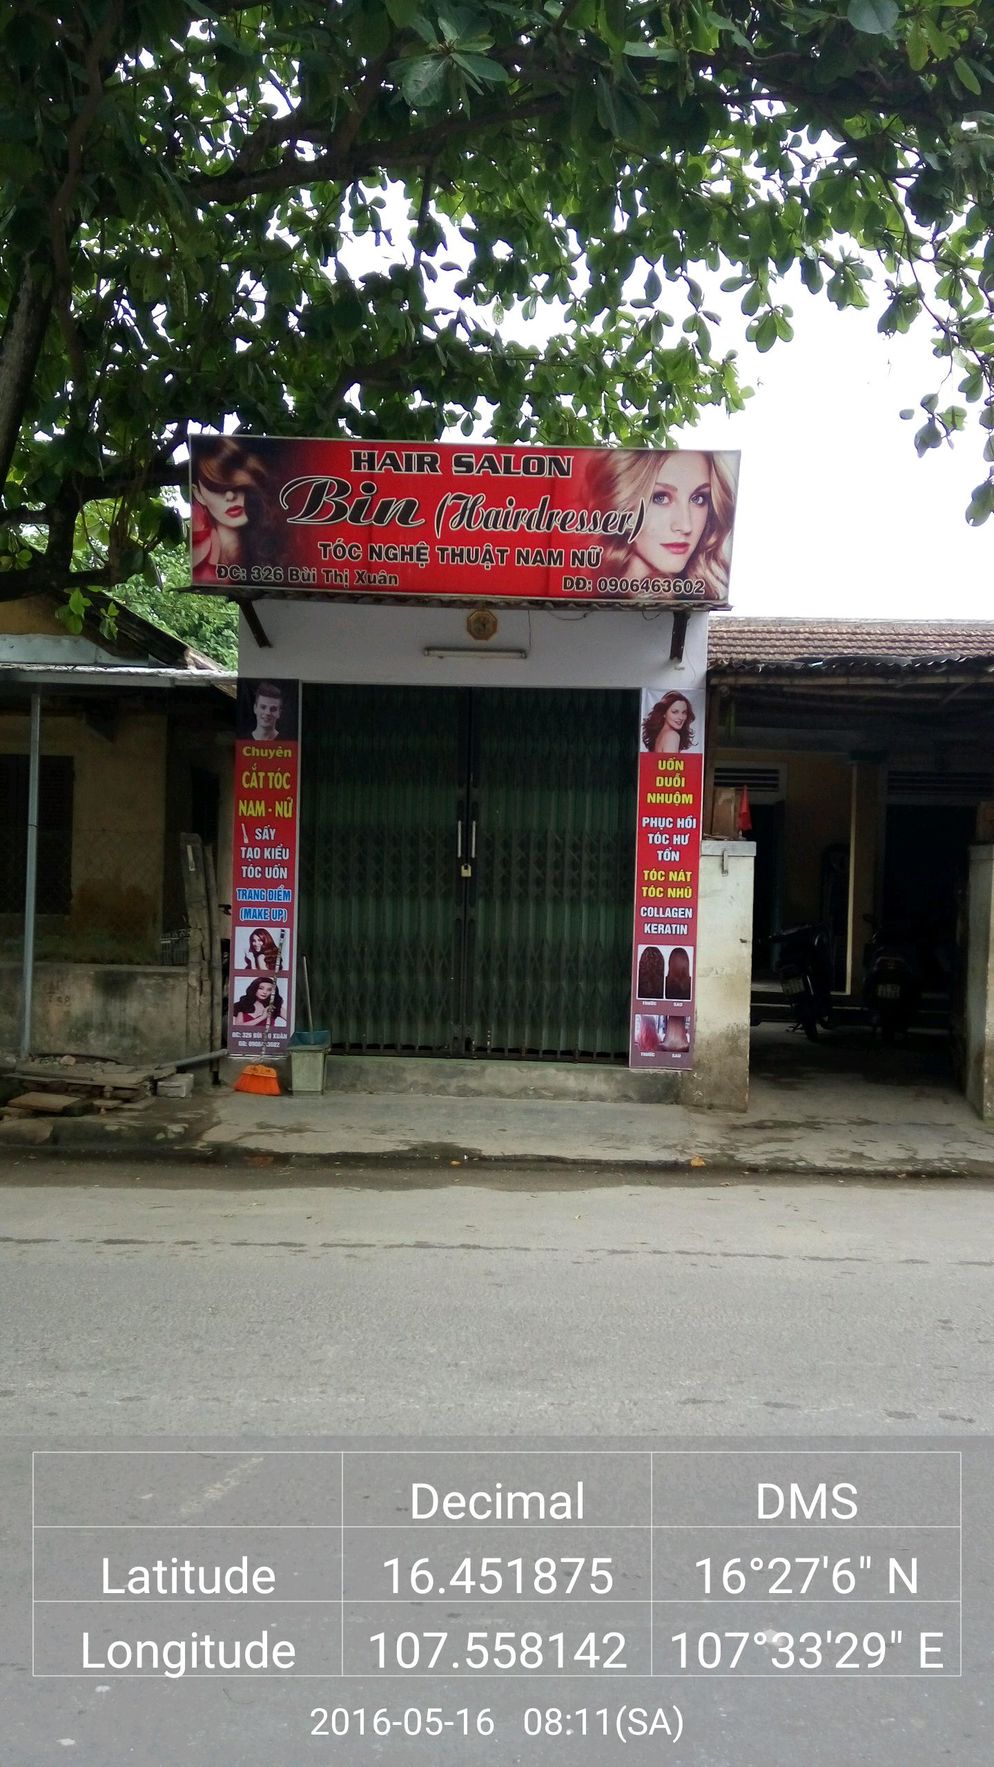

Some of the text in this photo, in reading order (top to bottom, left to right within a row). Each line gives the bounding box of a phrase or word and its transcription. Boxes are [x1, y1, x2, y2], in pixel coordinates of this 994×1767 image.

[351, 450, 574, 478] HAIR SALON
[279, 475, 645, 544] Bin (Hairdresser)
[318, 538, 604, 570] TÓC NGHỆ THUẬT NAM NỮ
[216, 565, 398, 588] ĐC: 326 Bùi Thị Xuân
[562, 576, 705, 594] DĐ: 0906463602
[243, 746, 292, 759] Chuyên
[658, 757, 684, 771] UỐN
[242, 763, 291, 789] CẮT TÓC
[655, 773, 686, 787] DUỖI
[647, 791, 693, 806] NHUỘM
[239, 799, 266, 817] NAM
[275, 796, 294, 818] NỮ
[642, 816, 673, 830] PHỤC
[255, 824, 276, 840] SẤY
[648, 831, 690, 845] TÓC HƯ
[240, 843, 290, 861] TẠO KIỂU
[241, 864, 288, 879] TÓC UỐN
[643, 868, 692, 882] TÓC NÁT
[236, 887, 267, 901] TRANG
[642, 885, 664, 898] TÓC
[240, 907, 288, 923] (MAKE UP)
[640, 906, 693, 919] COLLAGEN
[644, 923, 688, 935] KERATIN
